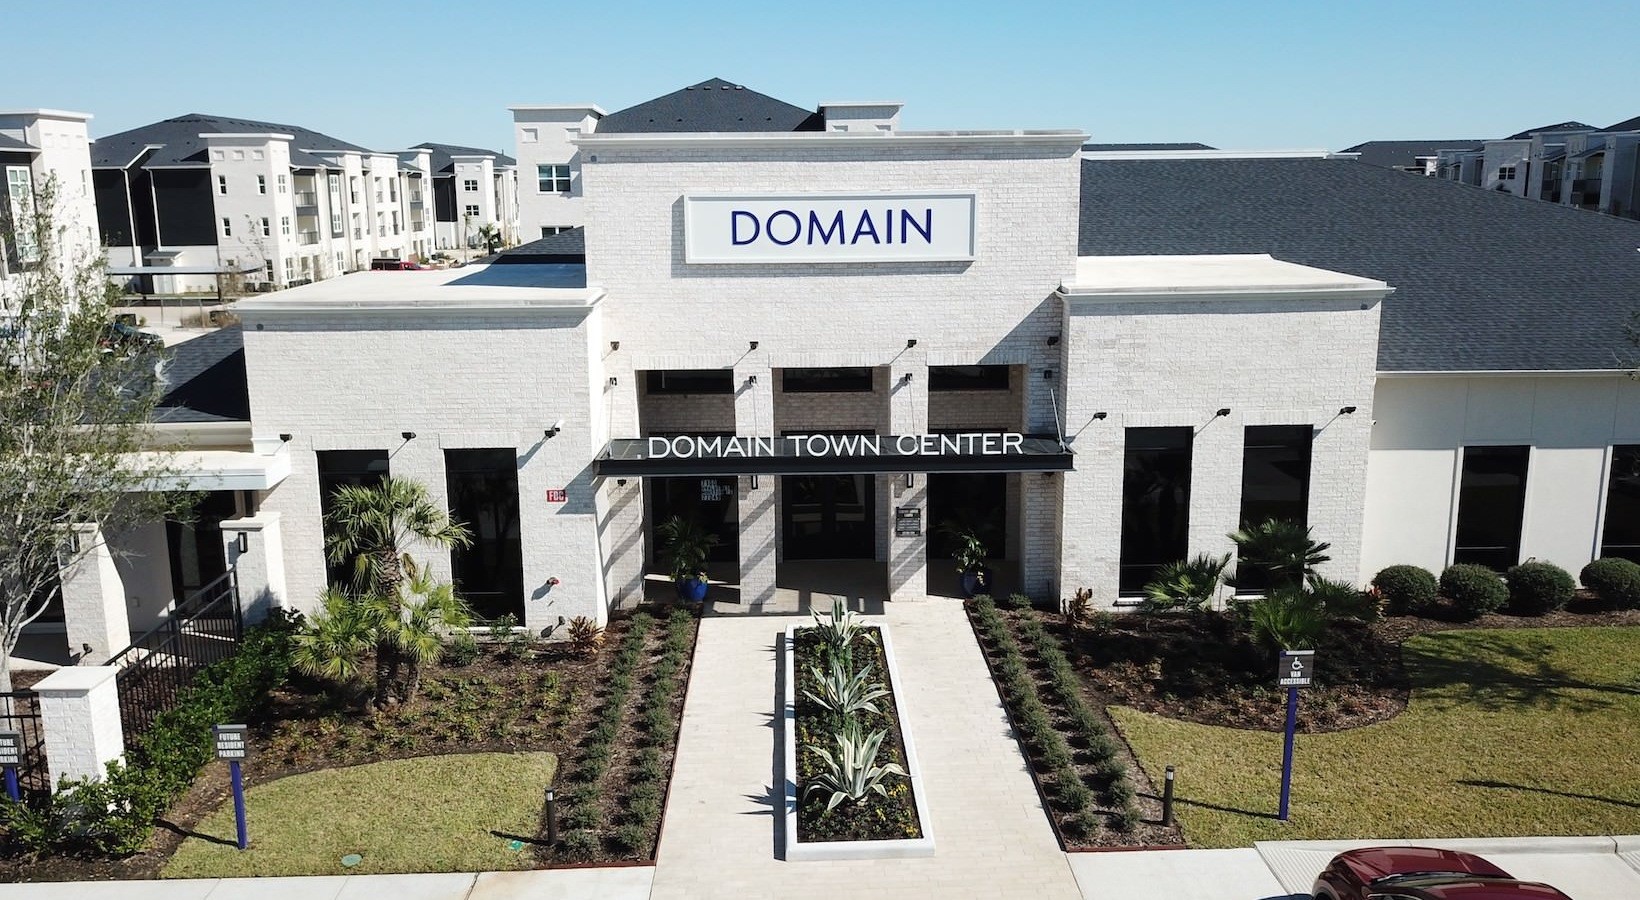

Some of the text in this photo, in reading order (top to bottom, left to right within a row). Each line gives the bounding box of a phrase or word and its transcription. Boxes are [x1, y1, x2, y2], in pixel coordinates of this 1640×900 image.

[731, 209, 932, 246] DOMAIN
[648, 432, 1024, 458] DOMAIN TOWN CENTER
[548, 490, 565, 501] FDC
[1280, 677, 1310, 685] ACCESSIBLE
[219, 732, 241, 741] FUTURE
[217, 741, 245, 750] RESIDENT
[218, 749, 245, 758] PARKING
